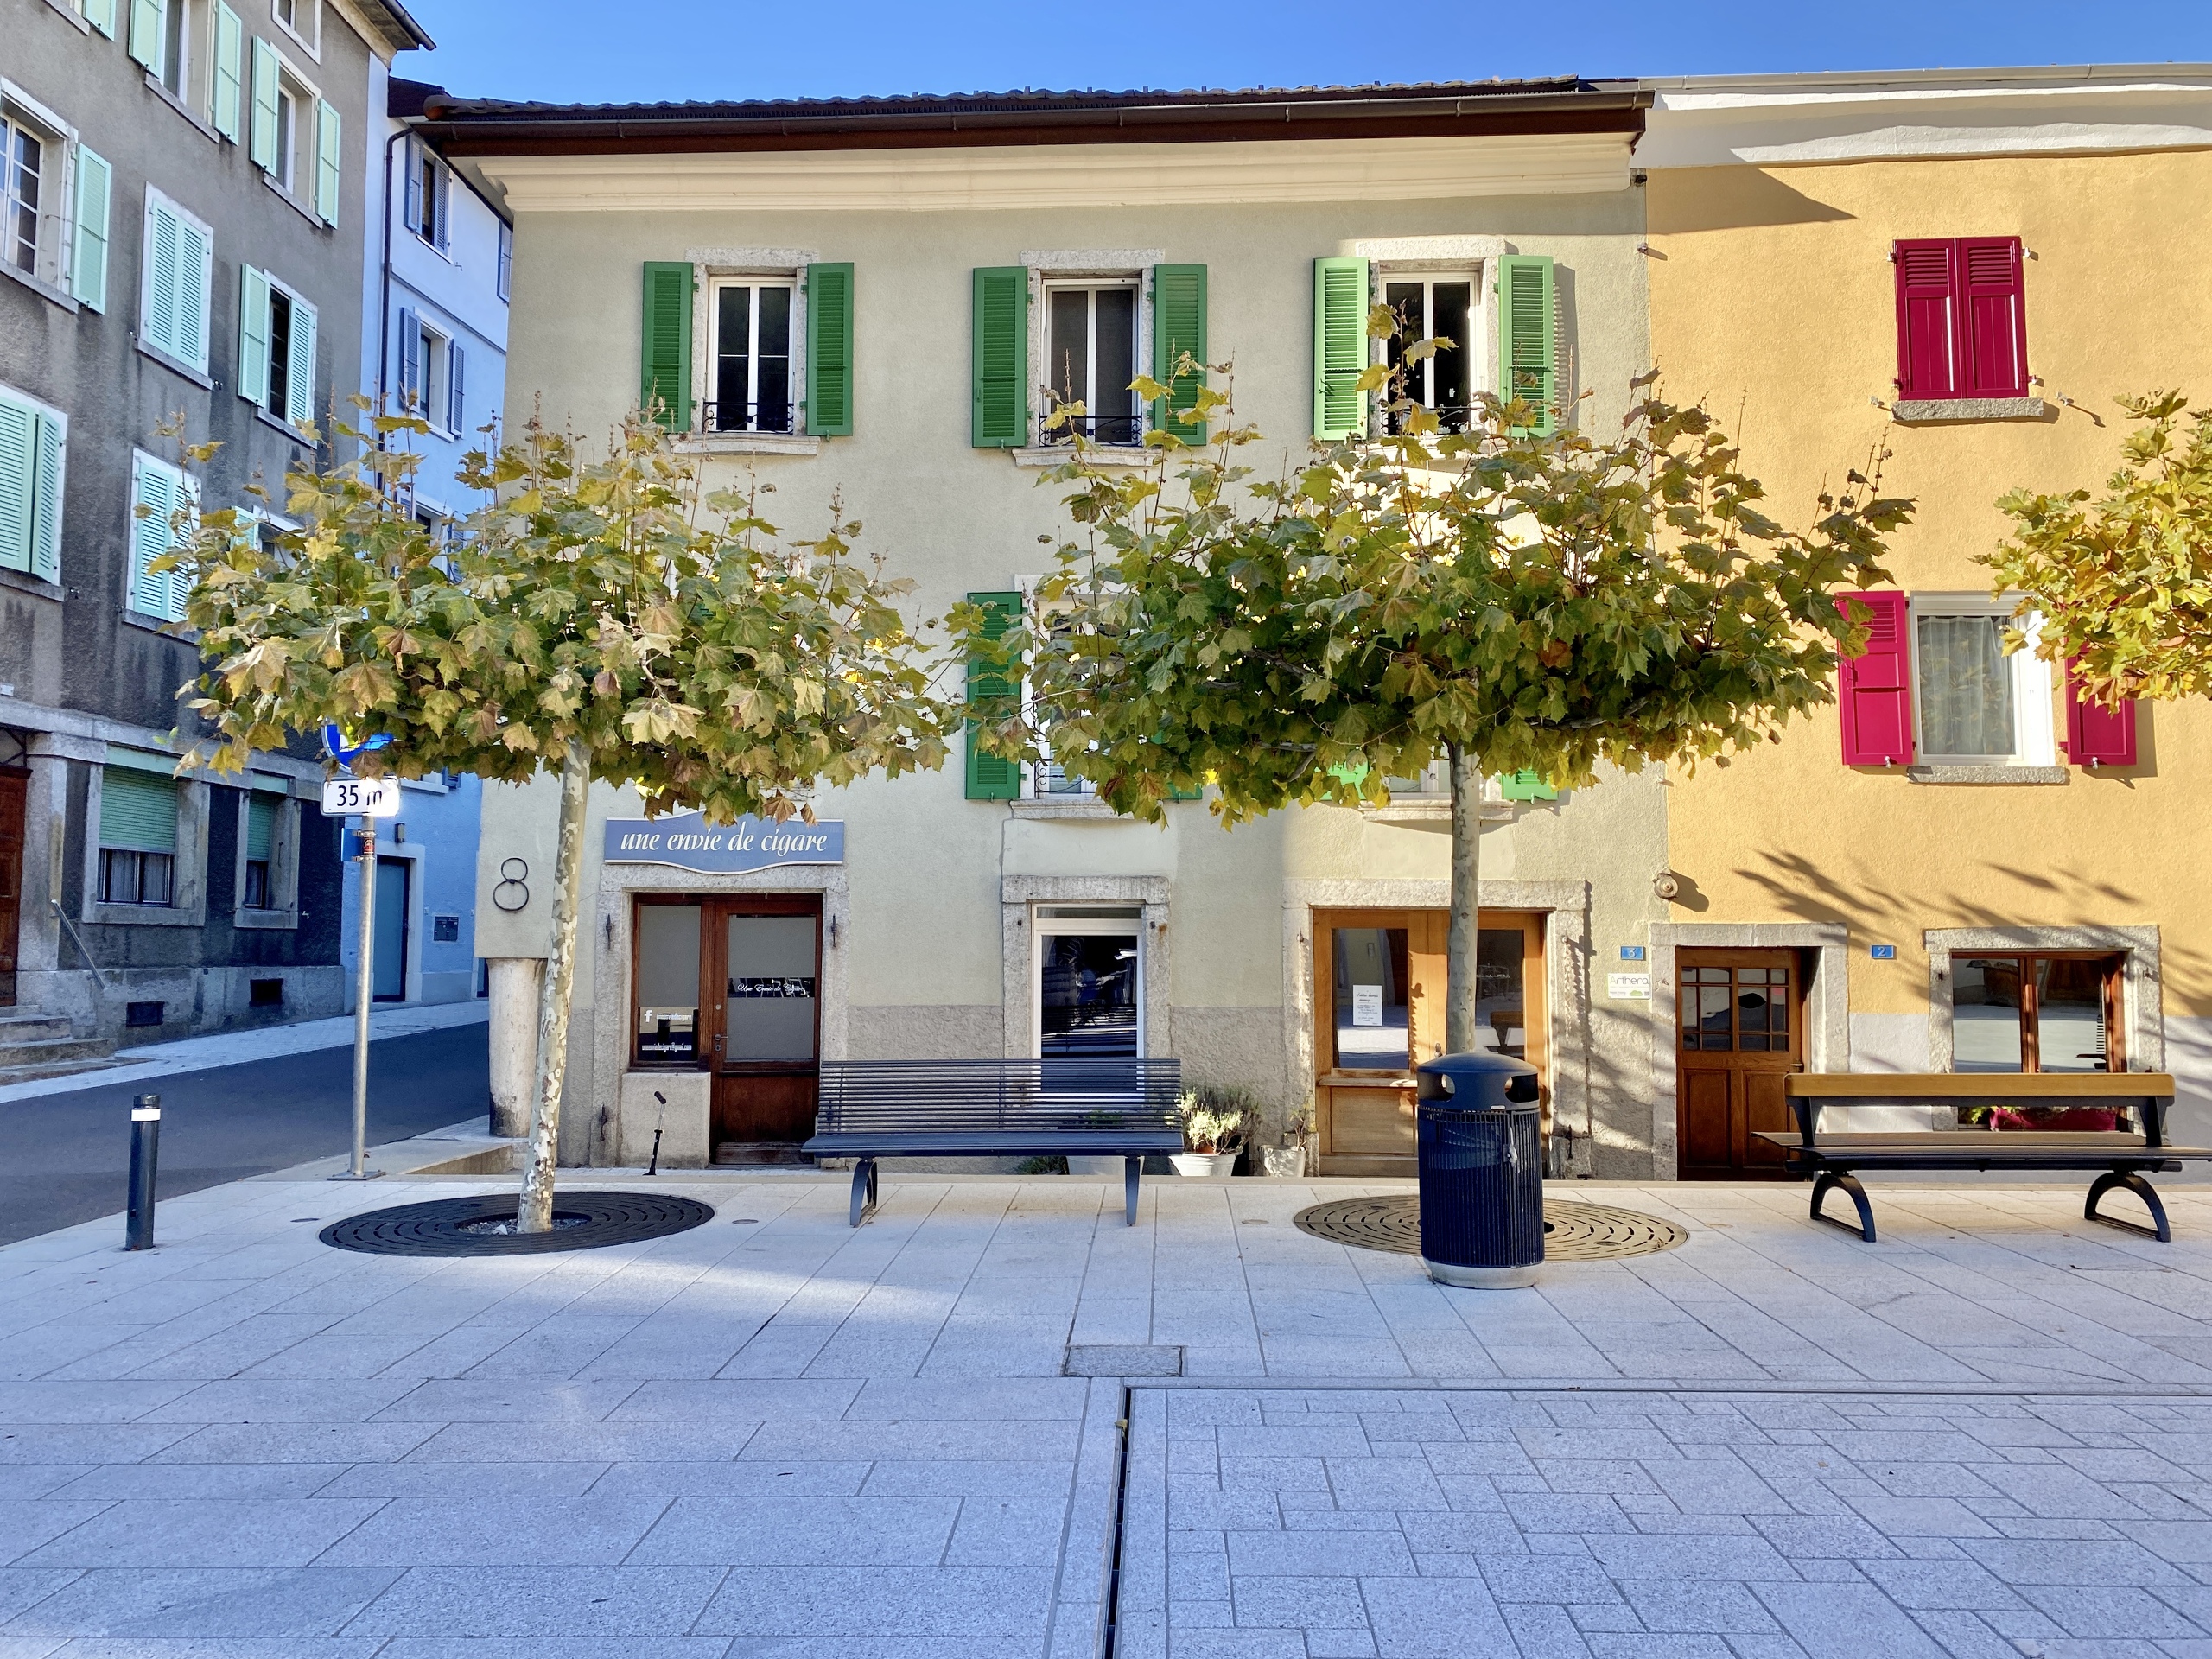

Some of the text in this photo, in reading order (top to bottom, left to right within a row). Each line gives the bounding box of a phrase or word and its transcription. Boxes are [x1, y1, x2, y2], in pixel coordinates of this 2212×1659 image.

[337, 785, 383, 807] 35 m
[620, 822, 828, 857] une envie de cigare
[1878, 946, 1885, 957] 2
[1610, 976, 1649, 985] Arthera
